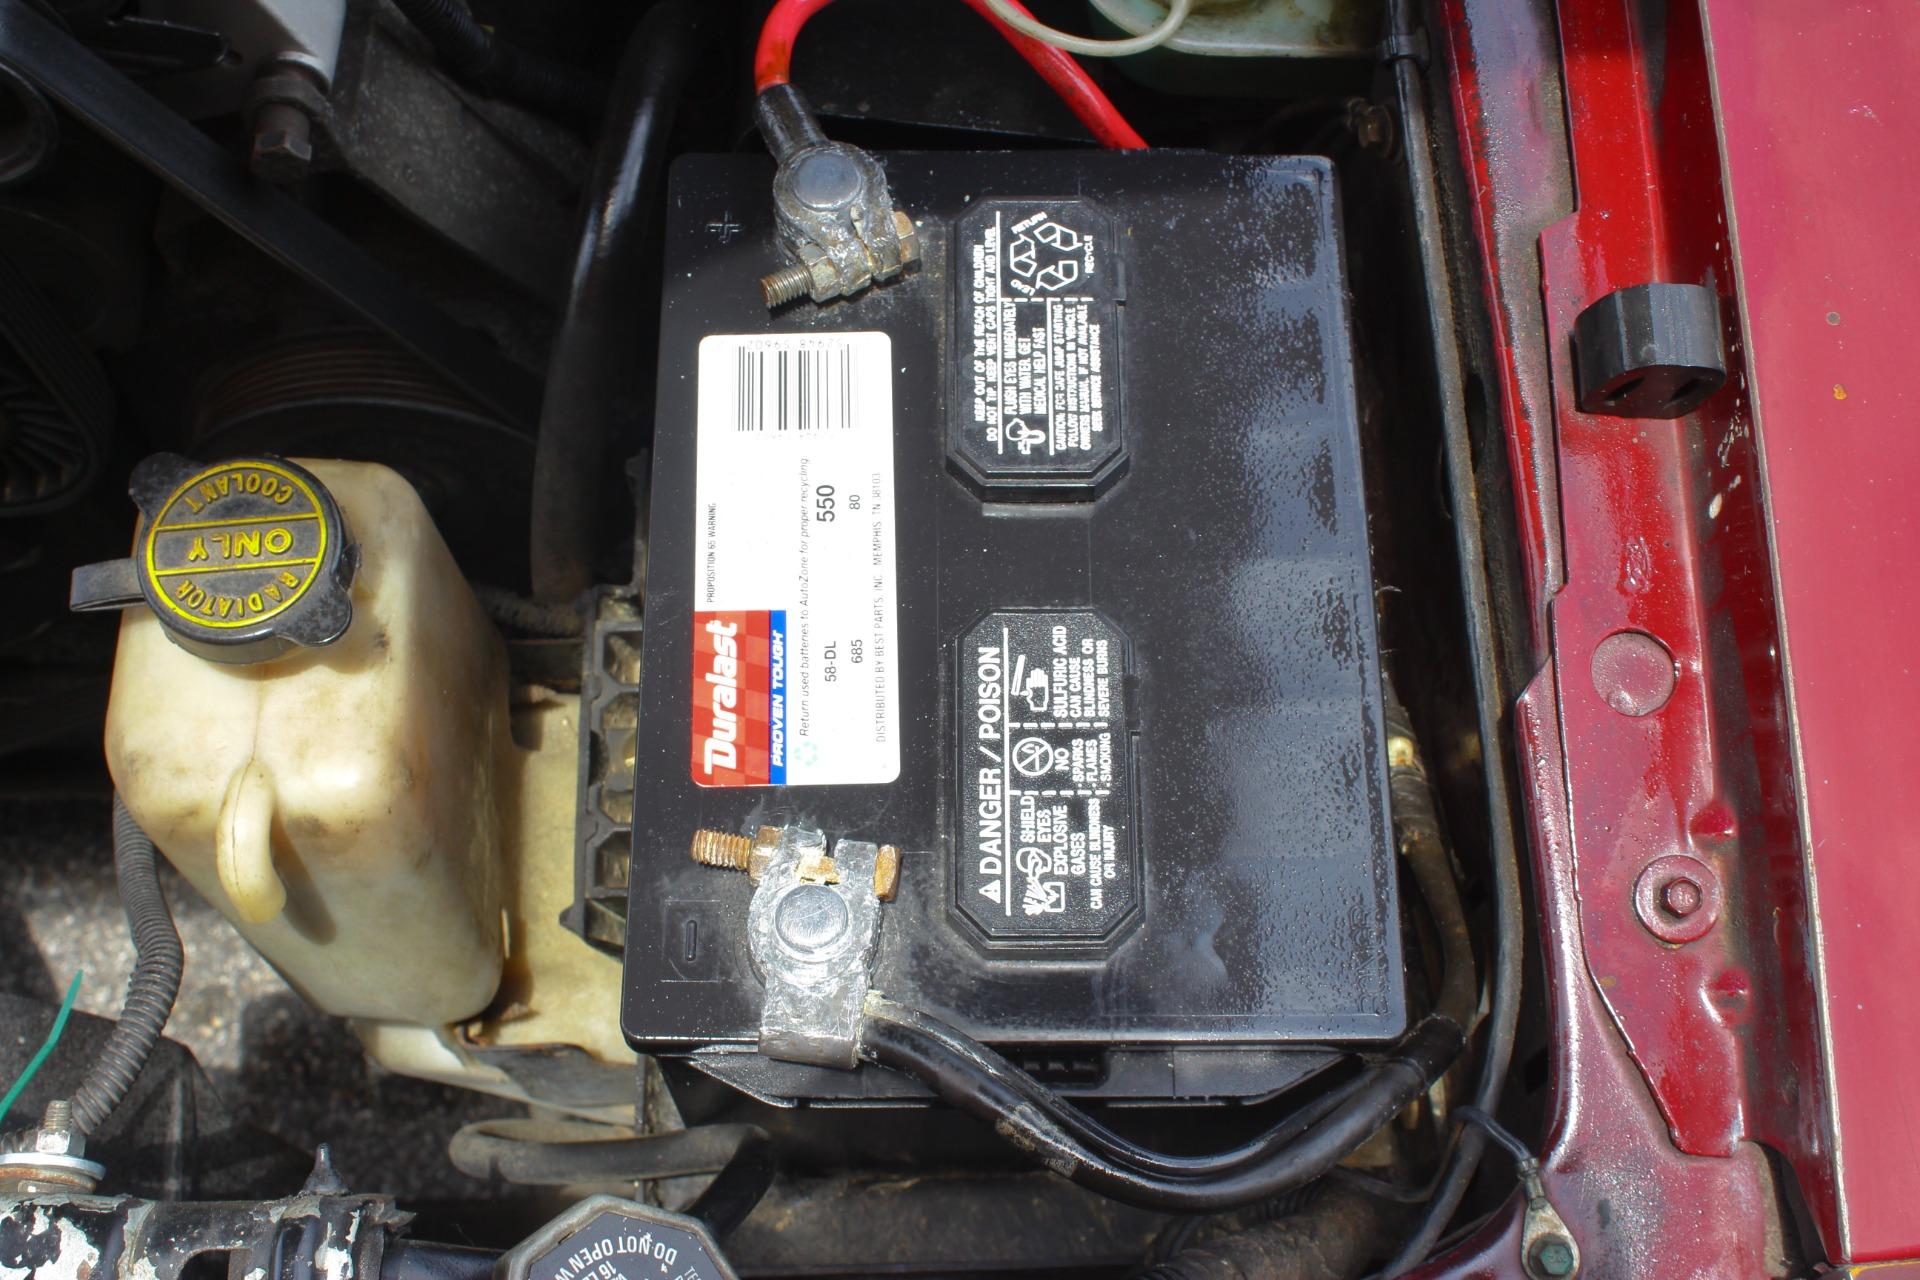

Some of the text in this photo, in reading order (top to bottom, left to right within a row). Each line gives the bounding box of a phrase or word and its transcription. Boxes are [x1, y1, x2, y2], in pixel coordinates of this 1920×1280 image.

[985, 255, 996, 273] AND
[1084, 235, 1095, 273] RECYCLE
[985, 276, 996, 301] TIGHT
[974, 245, 985, 421] KEEP OUT OF THE REACH OF CHILDREN
[985, 306, 996, 327] CAPS
[1053, 304, 1064, 344] STARTING
[1077, 304, 1089, 344] AVAILABLE
[986, 329, 996, 355] VENT
[1004, 301, 1017, 414] FLUSH EYES IMMEDIATELY
[1018, 338, 1030, 355] GET
[1054, 346, 1065, 367] JUMP
[1079, 347, 1089, 364] NOT
[986, 358, 996, 382] KEEP
[1033, 327, 1046, 414] MEDICAL HELP FAST
[1054, 370, 1065, 391] SAFE
[1066, 308, 1078, 447] FOLLOW INSTRUCTIONS IN VEHICLE
[1090, 324, 1102, 431] SEEK SERVICE ASSISTANCE
[987, 407, 997, 424] NOT
[1019, 391, 1031, 414] WITH
[1055, 394, 1065, 410] FOR
[987, 428, 997, 441] DO
[184, 473, 293, 513] COOLANT
[816, 485, 836, 522] 550
[849, 494, 861, 510] 80
[188, 528, 293, 561] ONLY
[706, 503, 717, 603] PROPOSITION 65 WARNING
[176, 571, 301, 617] RADIATOR
[797, 458, 812, 737] Return used batteries to AutoZone for proper recycling
[824, 641, 837, 682] 58-DL
[851, 639, 863, 664] 685
[874, 631, 886, 657] BEST
[875, 659, 886, 674] BY
[1053, 626, 1068, 718] SULFURIC ACID
[1083, 639, 1096, 717] BLINDNESS OR
[1096, 639, 1109, 717] SEVERE BURNS
[704, 618, 738, 775] Duralast
[1069, 657, 1081, 717] CAN CAUSE
[875, 676, 887, 743] DISTRIBUTED
[772, 693, 784, 767] PROVEN
[978, 647, 1002, 874] DANGER / POISON
[1056, 748, 1070, 770] NO
[1020, 796, 1035, 843] SHIELD
[1037, 809, 1051, 843] EYES
[1053, 805, 1068, 875] EXPLOSIVE
[1071, 832, 1086, 875] GASES
[1089, 798, 1103, 909] CAN CAUSE BLINDNESS
[1103, 824, 1116, 878] OR INJURY
[568, 1236, 678, 1273] DO NOT OPEN
[599, 1260, 617, 1279] 16
